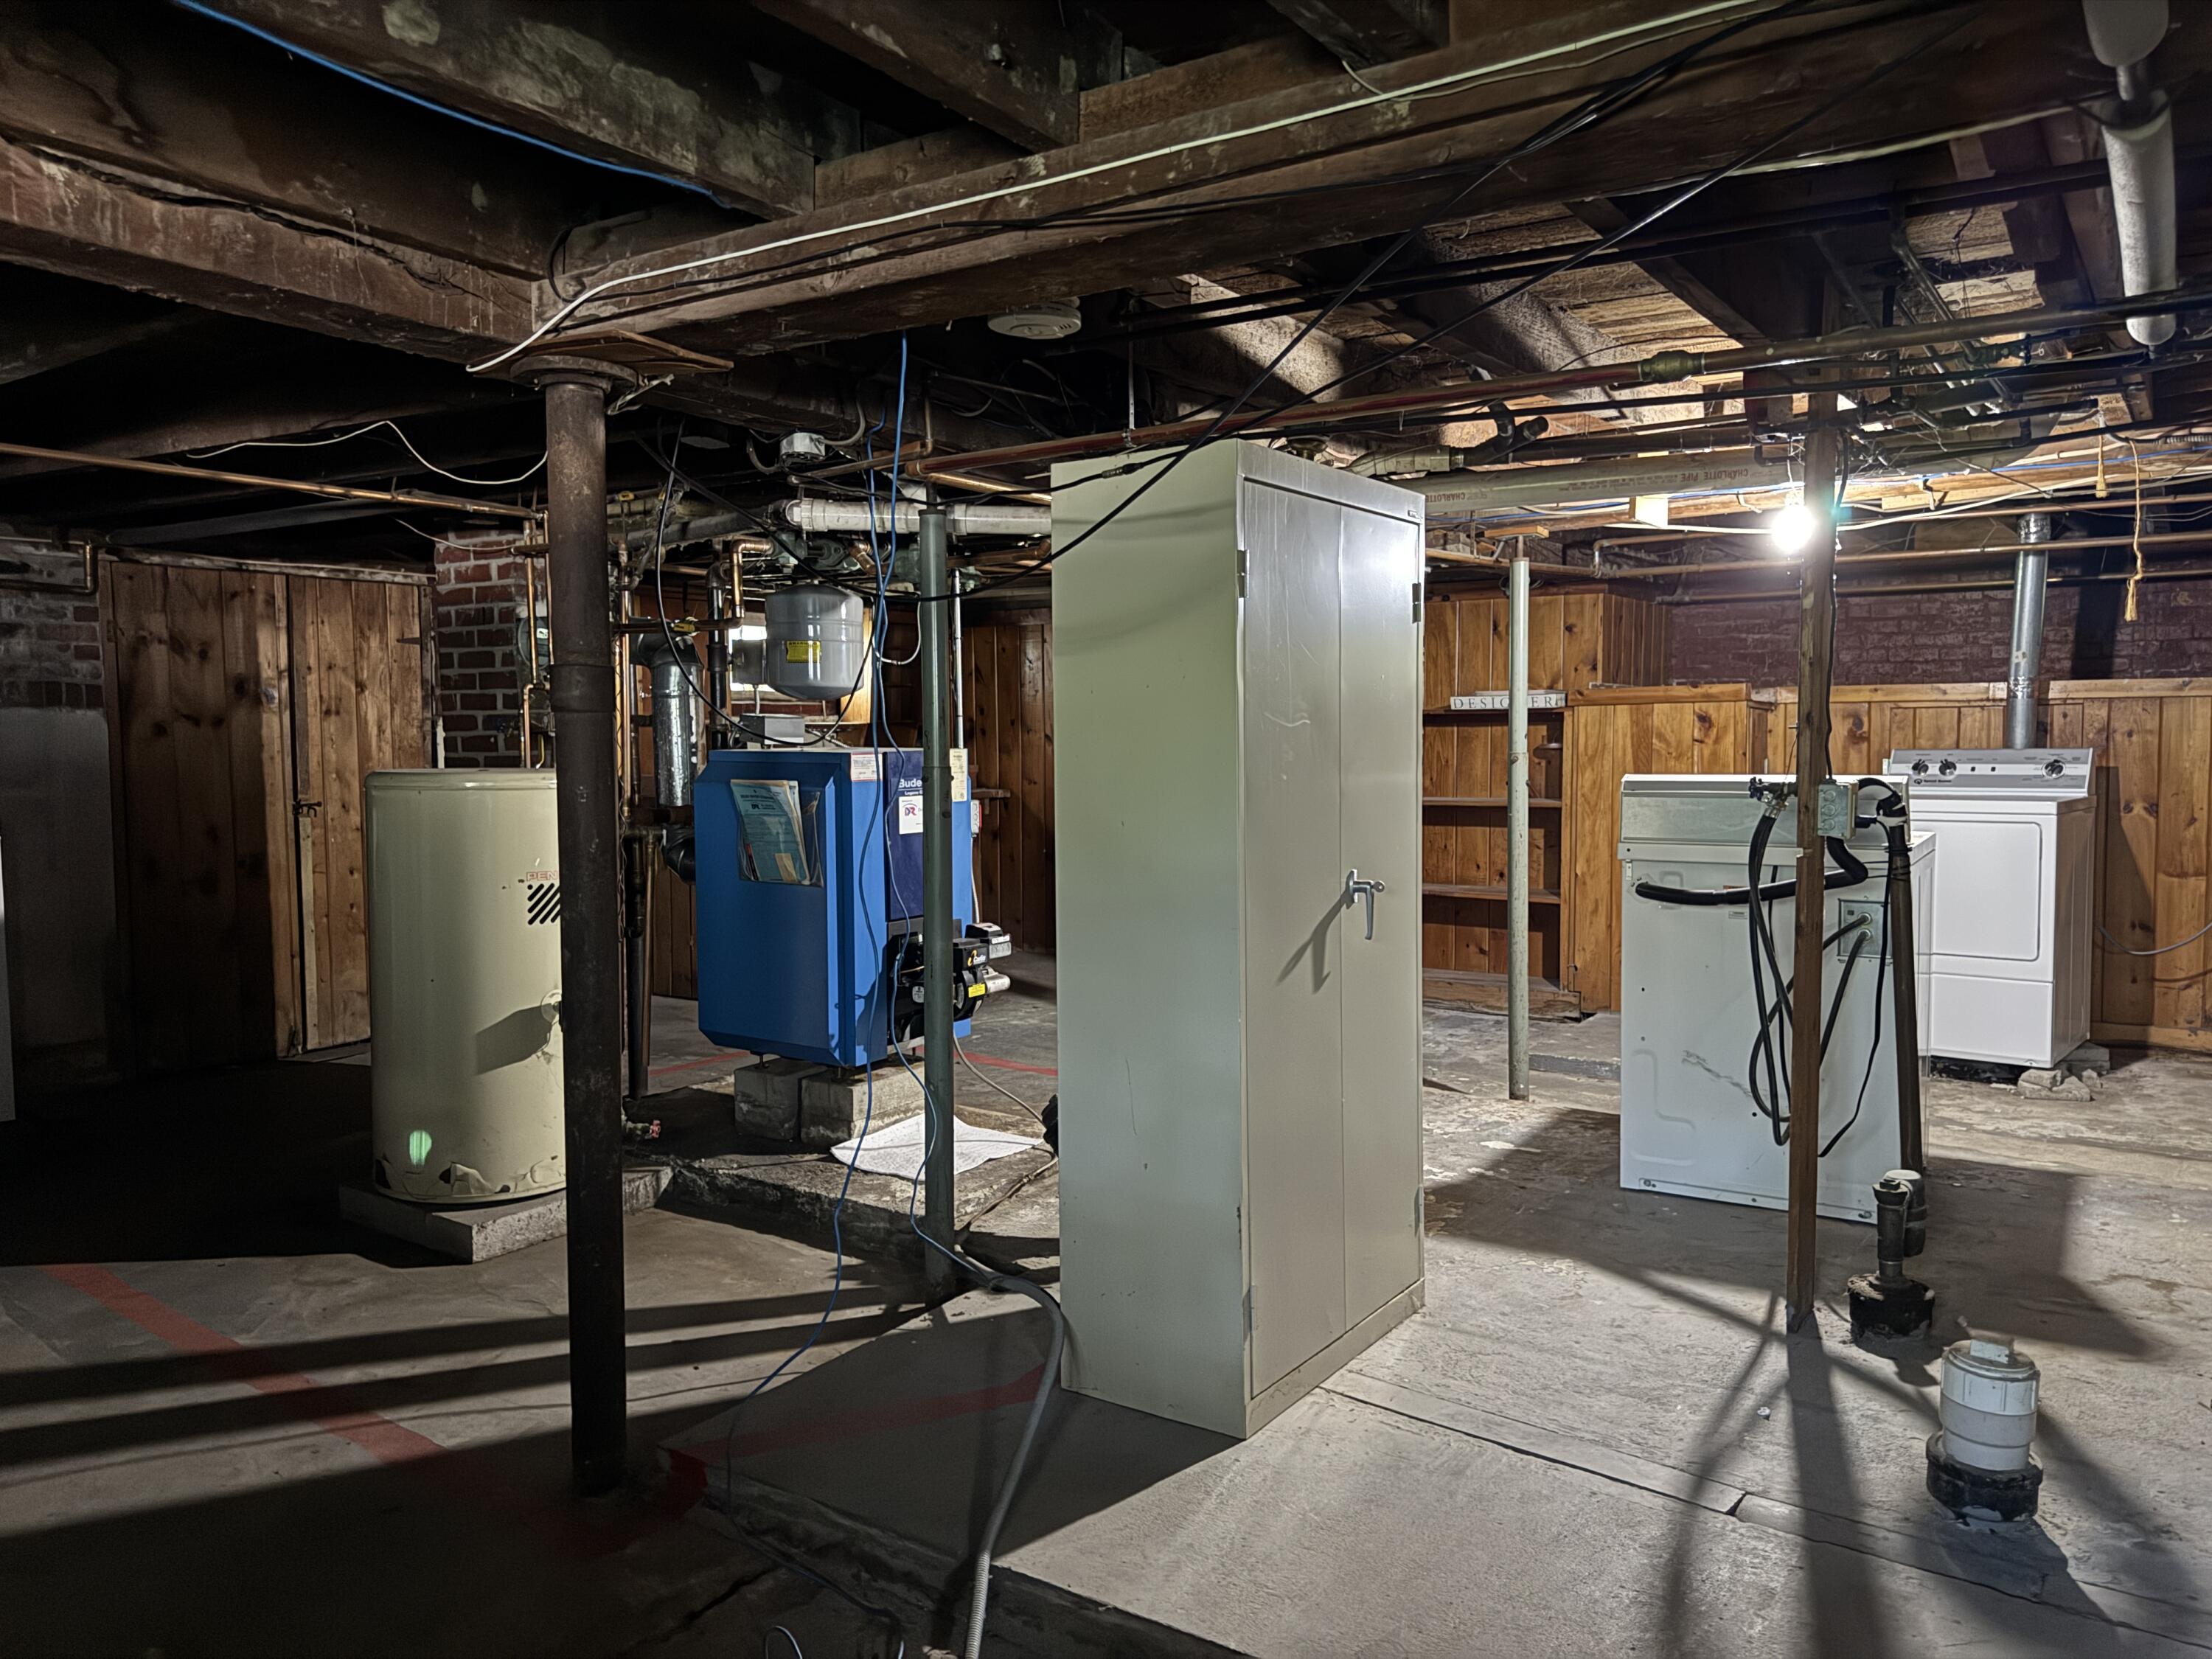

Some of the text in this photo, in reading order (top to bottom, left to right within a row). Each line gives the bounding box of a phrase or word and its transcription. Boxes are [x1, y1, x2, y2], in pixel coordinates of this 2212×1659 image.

[1680, 469, 1748, 482] CHARLOTTE PIPE
[1425, 492, 1466, 503] CHARLOTTE
[1453, 695, 1553, 709] DESIGER
[526, 871, 559, 882] PEN
